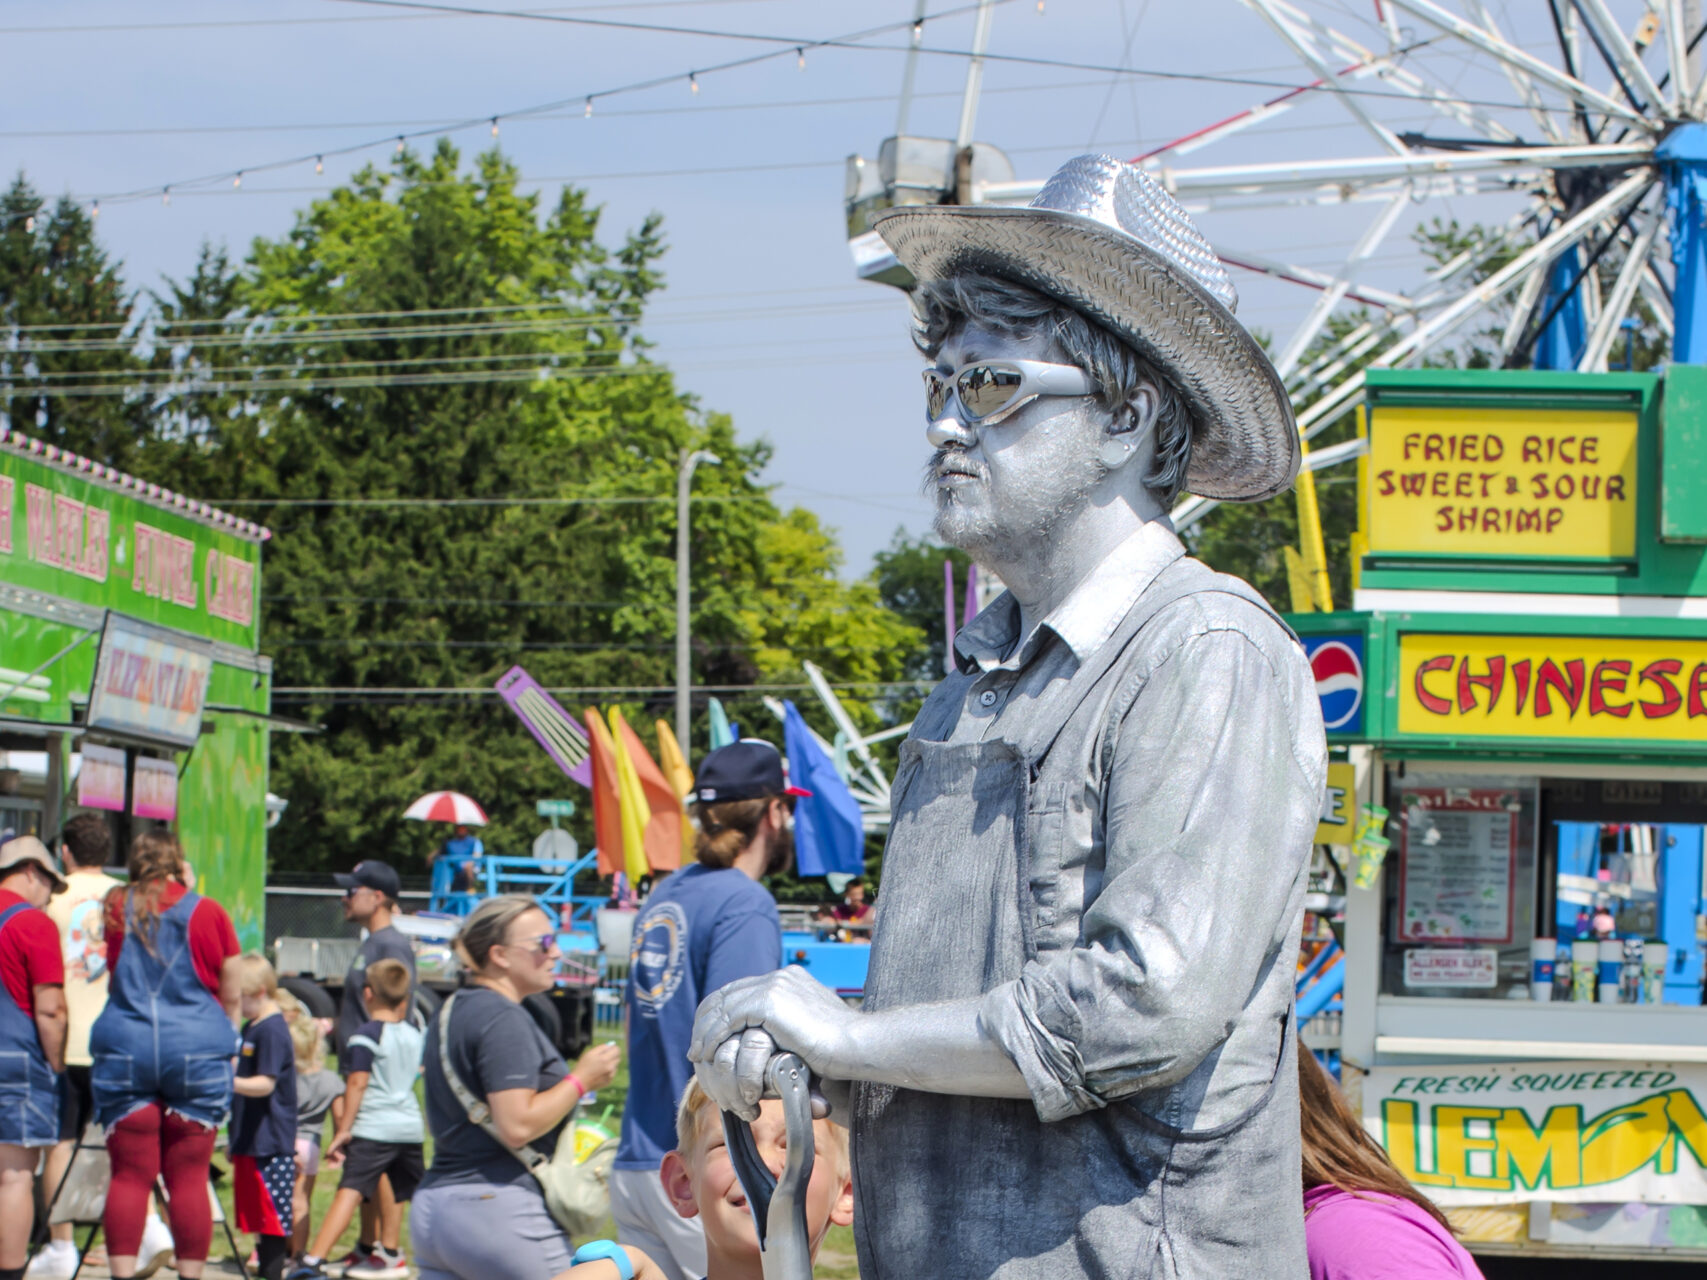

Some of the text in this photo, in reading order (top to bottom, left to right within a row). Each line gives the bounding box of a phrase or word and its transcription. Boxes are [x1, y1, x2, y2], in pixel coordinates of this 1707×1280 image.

[1403, 432, 1600, 465] FRIED RICE
[1376, 469, 1626, 502] SWEET & SOUR
[1436, 506, 1565, 534] SHRIMP
[25, 482, 110, 584] WAFFLES
[204, 547, 254, 627] CAKES
[1392, 1070, 1678, 1095] FRESH SQUEEZED
